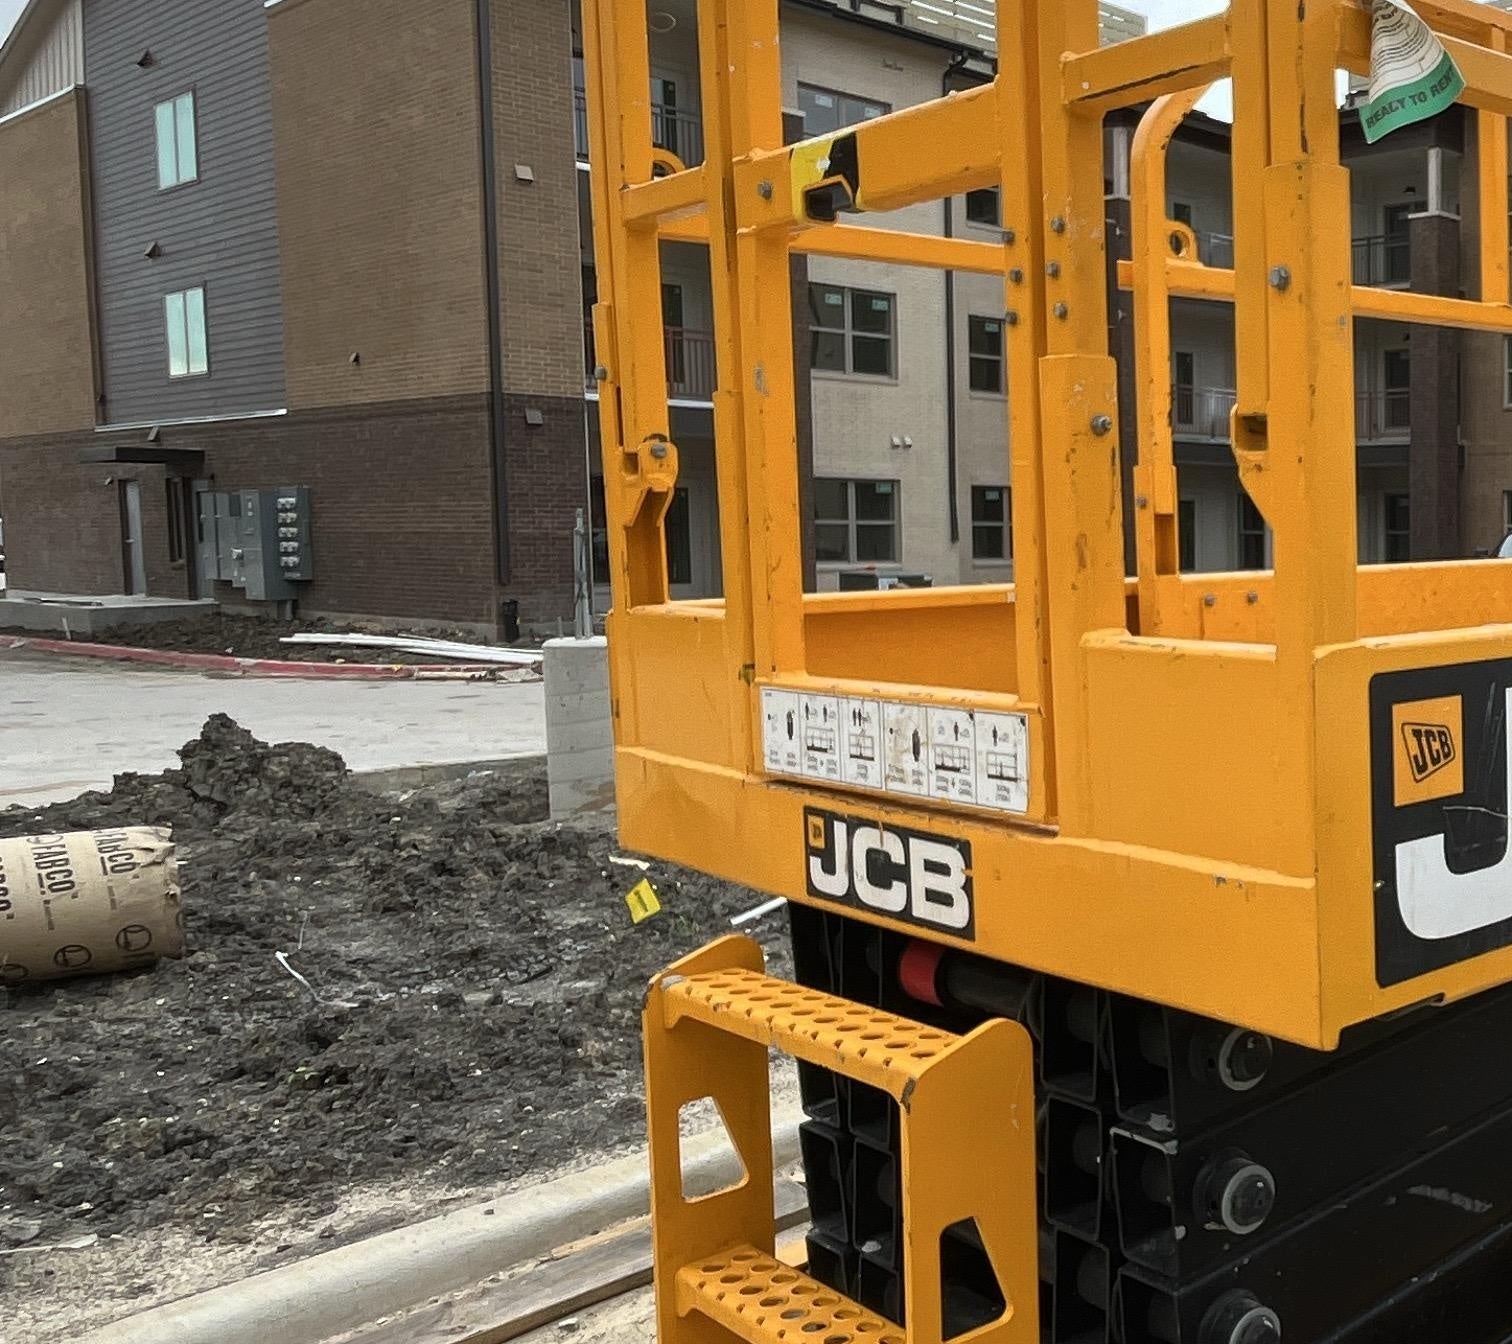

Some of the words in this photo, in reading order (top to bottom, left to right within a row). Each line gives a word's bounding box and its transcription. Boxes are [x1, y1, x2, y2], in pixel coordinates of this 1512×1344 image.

[1366, 97, 1407, 129] READY
[1408, 90, 1428, 106] TO
[1410, 726, 1452, 775] JCB
[809, 820, 971, 929] JCB
